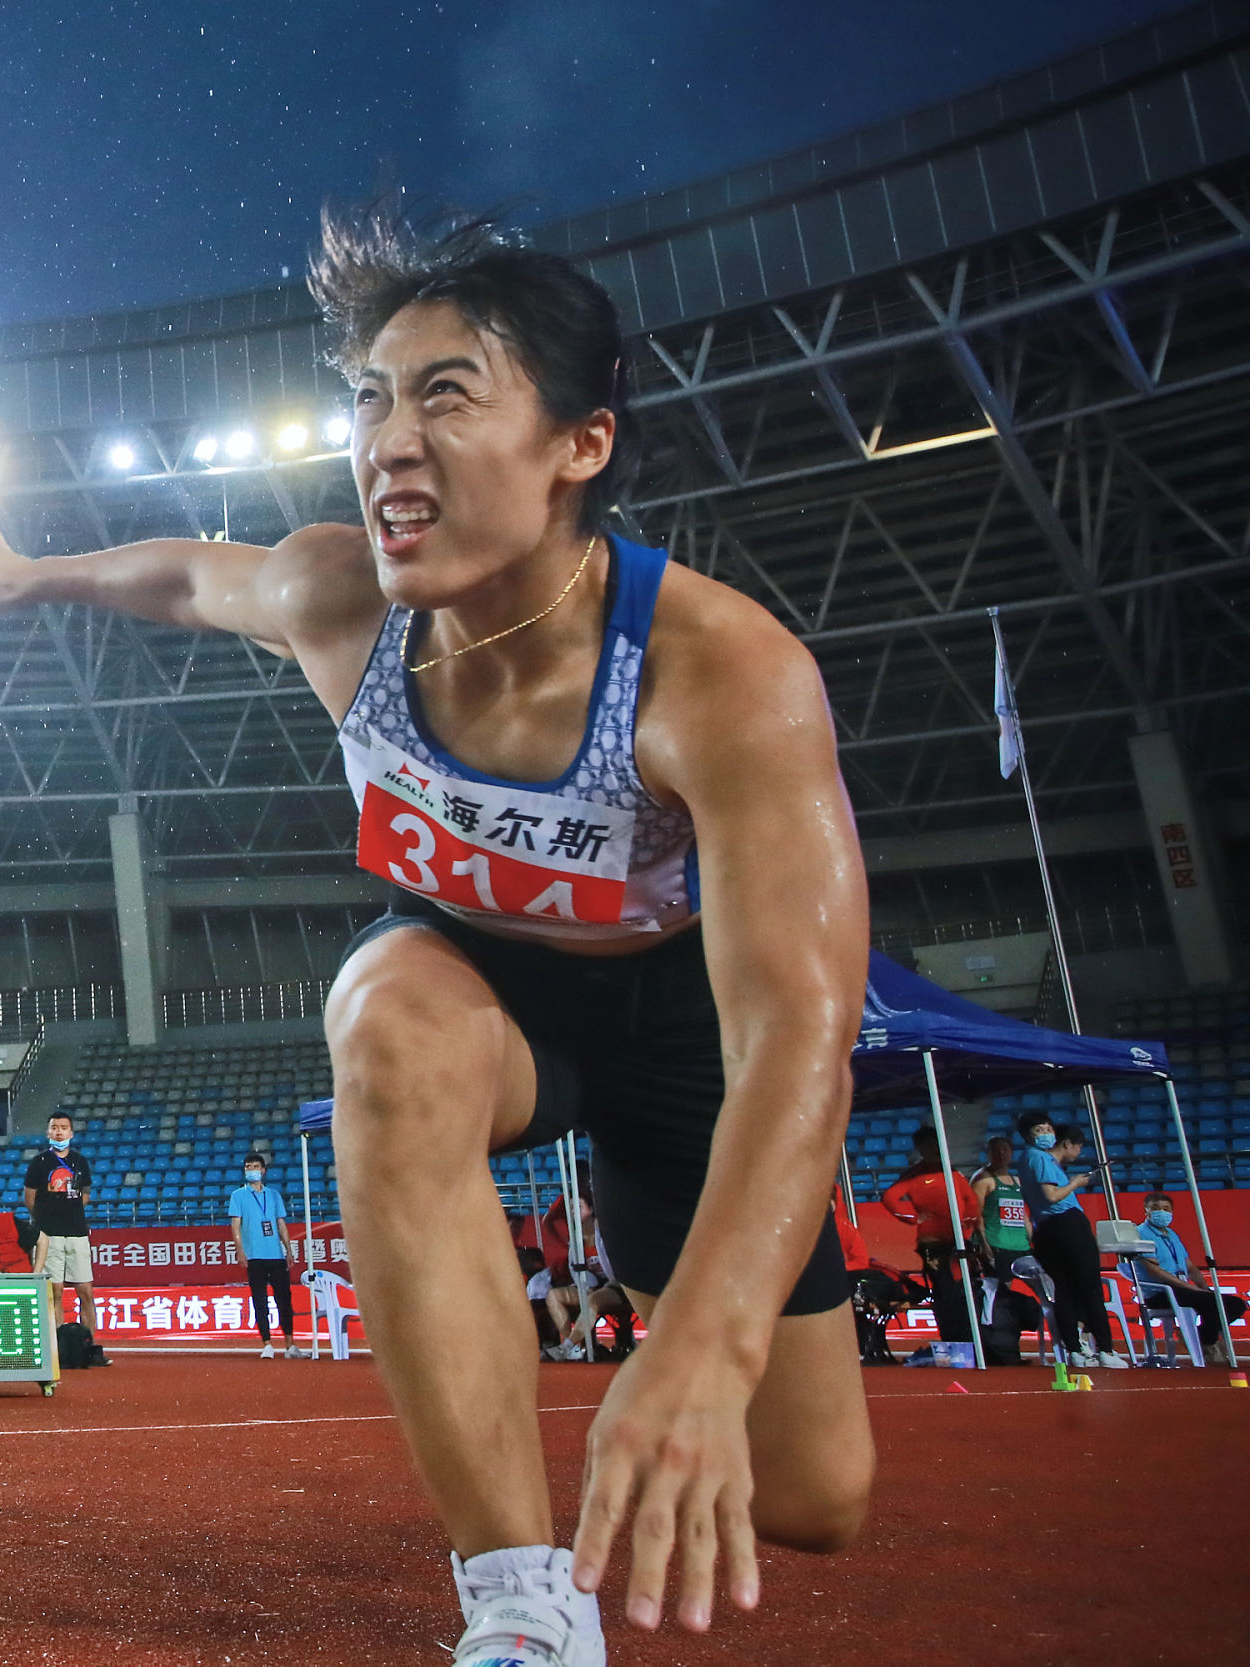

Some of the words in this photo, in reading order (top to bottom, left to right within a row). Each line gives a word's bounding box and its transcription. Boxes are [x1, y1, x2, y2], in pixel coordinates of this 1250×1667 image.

[388, 812, 579, 921] 314
[441, 789, 611, 863] 海尔斯
